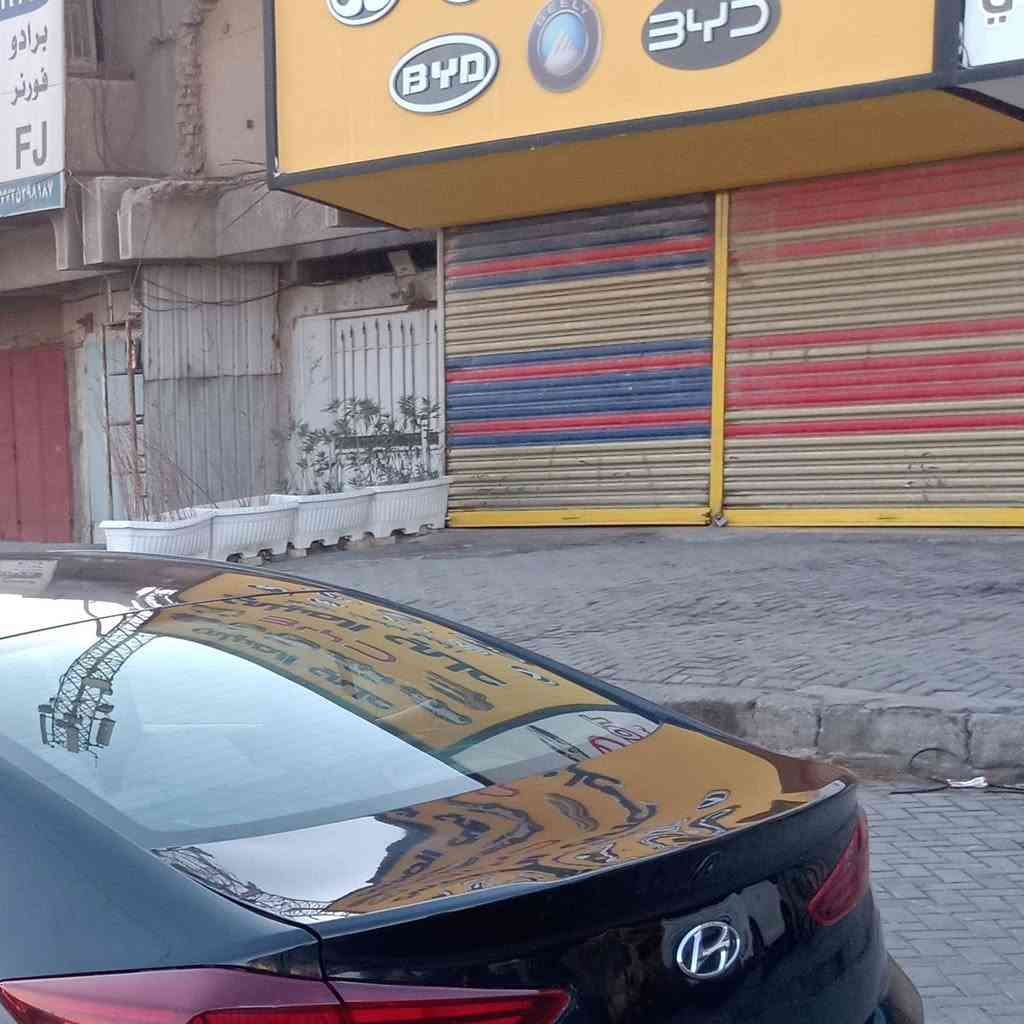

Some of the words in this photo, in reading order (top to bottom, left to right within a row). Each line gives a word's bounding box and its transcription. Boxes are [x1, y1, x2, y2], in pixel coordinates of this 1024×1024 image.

[9, 22, 48, 60] برادو
[649, 0, 772, 51] BYD
[402, 51, 486, 96] BYD
[15, 120, 48, 170] FJ
